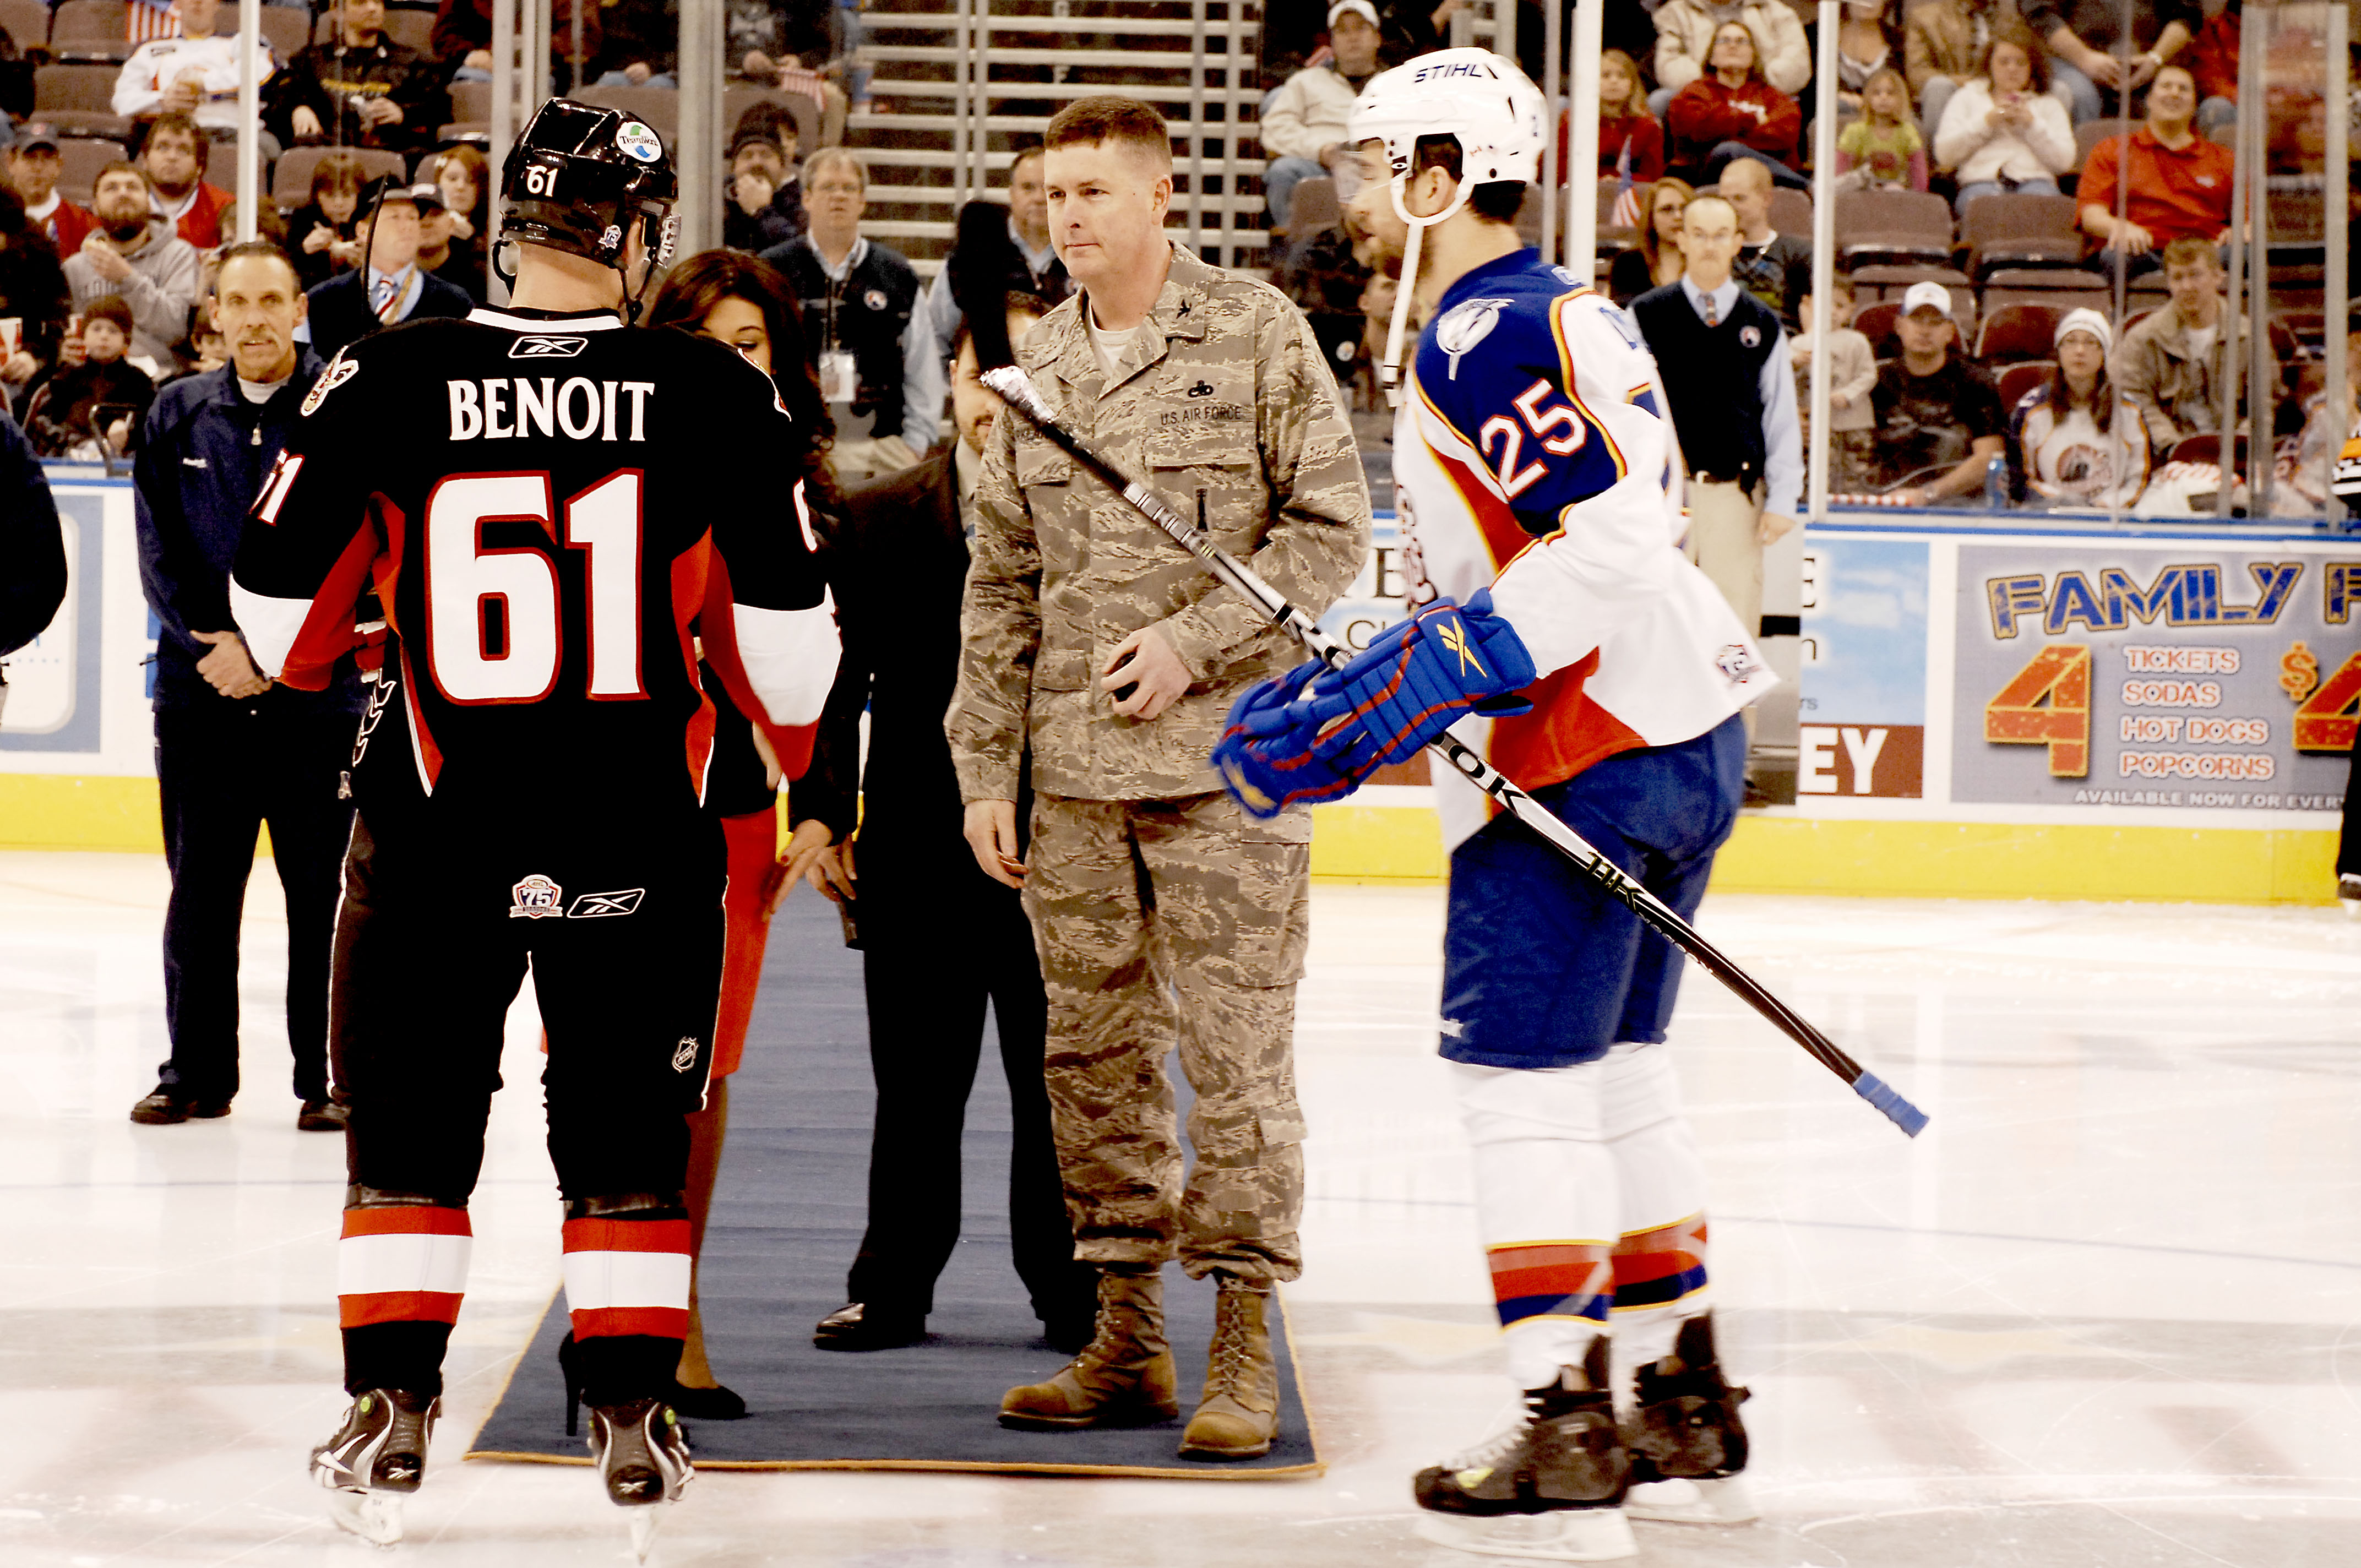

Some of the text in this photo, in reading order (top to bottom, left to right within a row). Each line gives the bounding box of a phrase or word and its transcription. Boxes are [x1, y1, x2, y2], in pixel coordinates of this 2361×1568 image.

[1413, 63, 1482, 83] STIHL
[526, 165, 558, 198] 61
[447, 377, 655, 441] BENOIT
[1160, 406, 1242, 426] U.S. AIR FORCE
[1479, 377, 1588, 502] 25
[423, 467, 651, 706] 61
[1987, 563, 2304, 639] FAMILY
[2124, 647, 2239, 673] TICKETS
[2123, 682, 2220, 707] SODAS
[1985, 644, 2091, 776] 4
[2121, 717, 2268, 744] HOT DOGS
[2121, 752, 2273, 779] POPCORNS
[2074, 790, 2183, 806] AVAILABLE
[2189, 792, 2235, 808] NOW
[2242, 793, 2281, 809] FOR
[521, 888, 552, 906] 75
